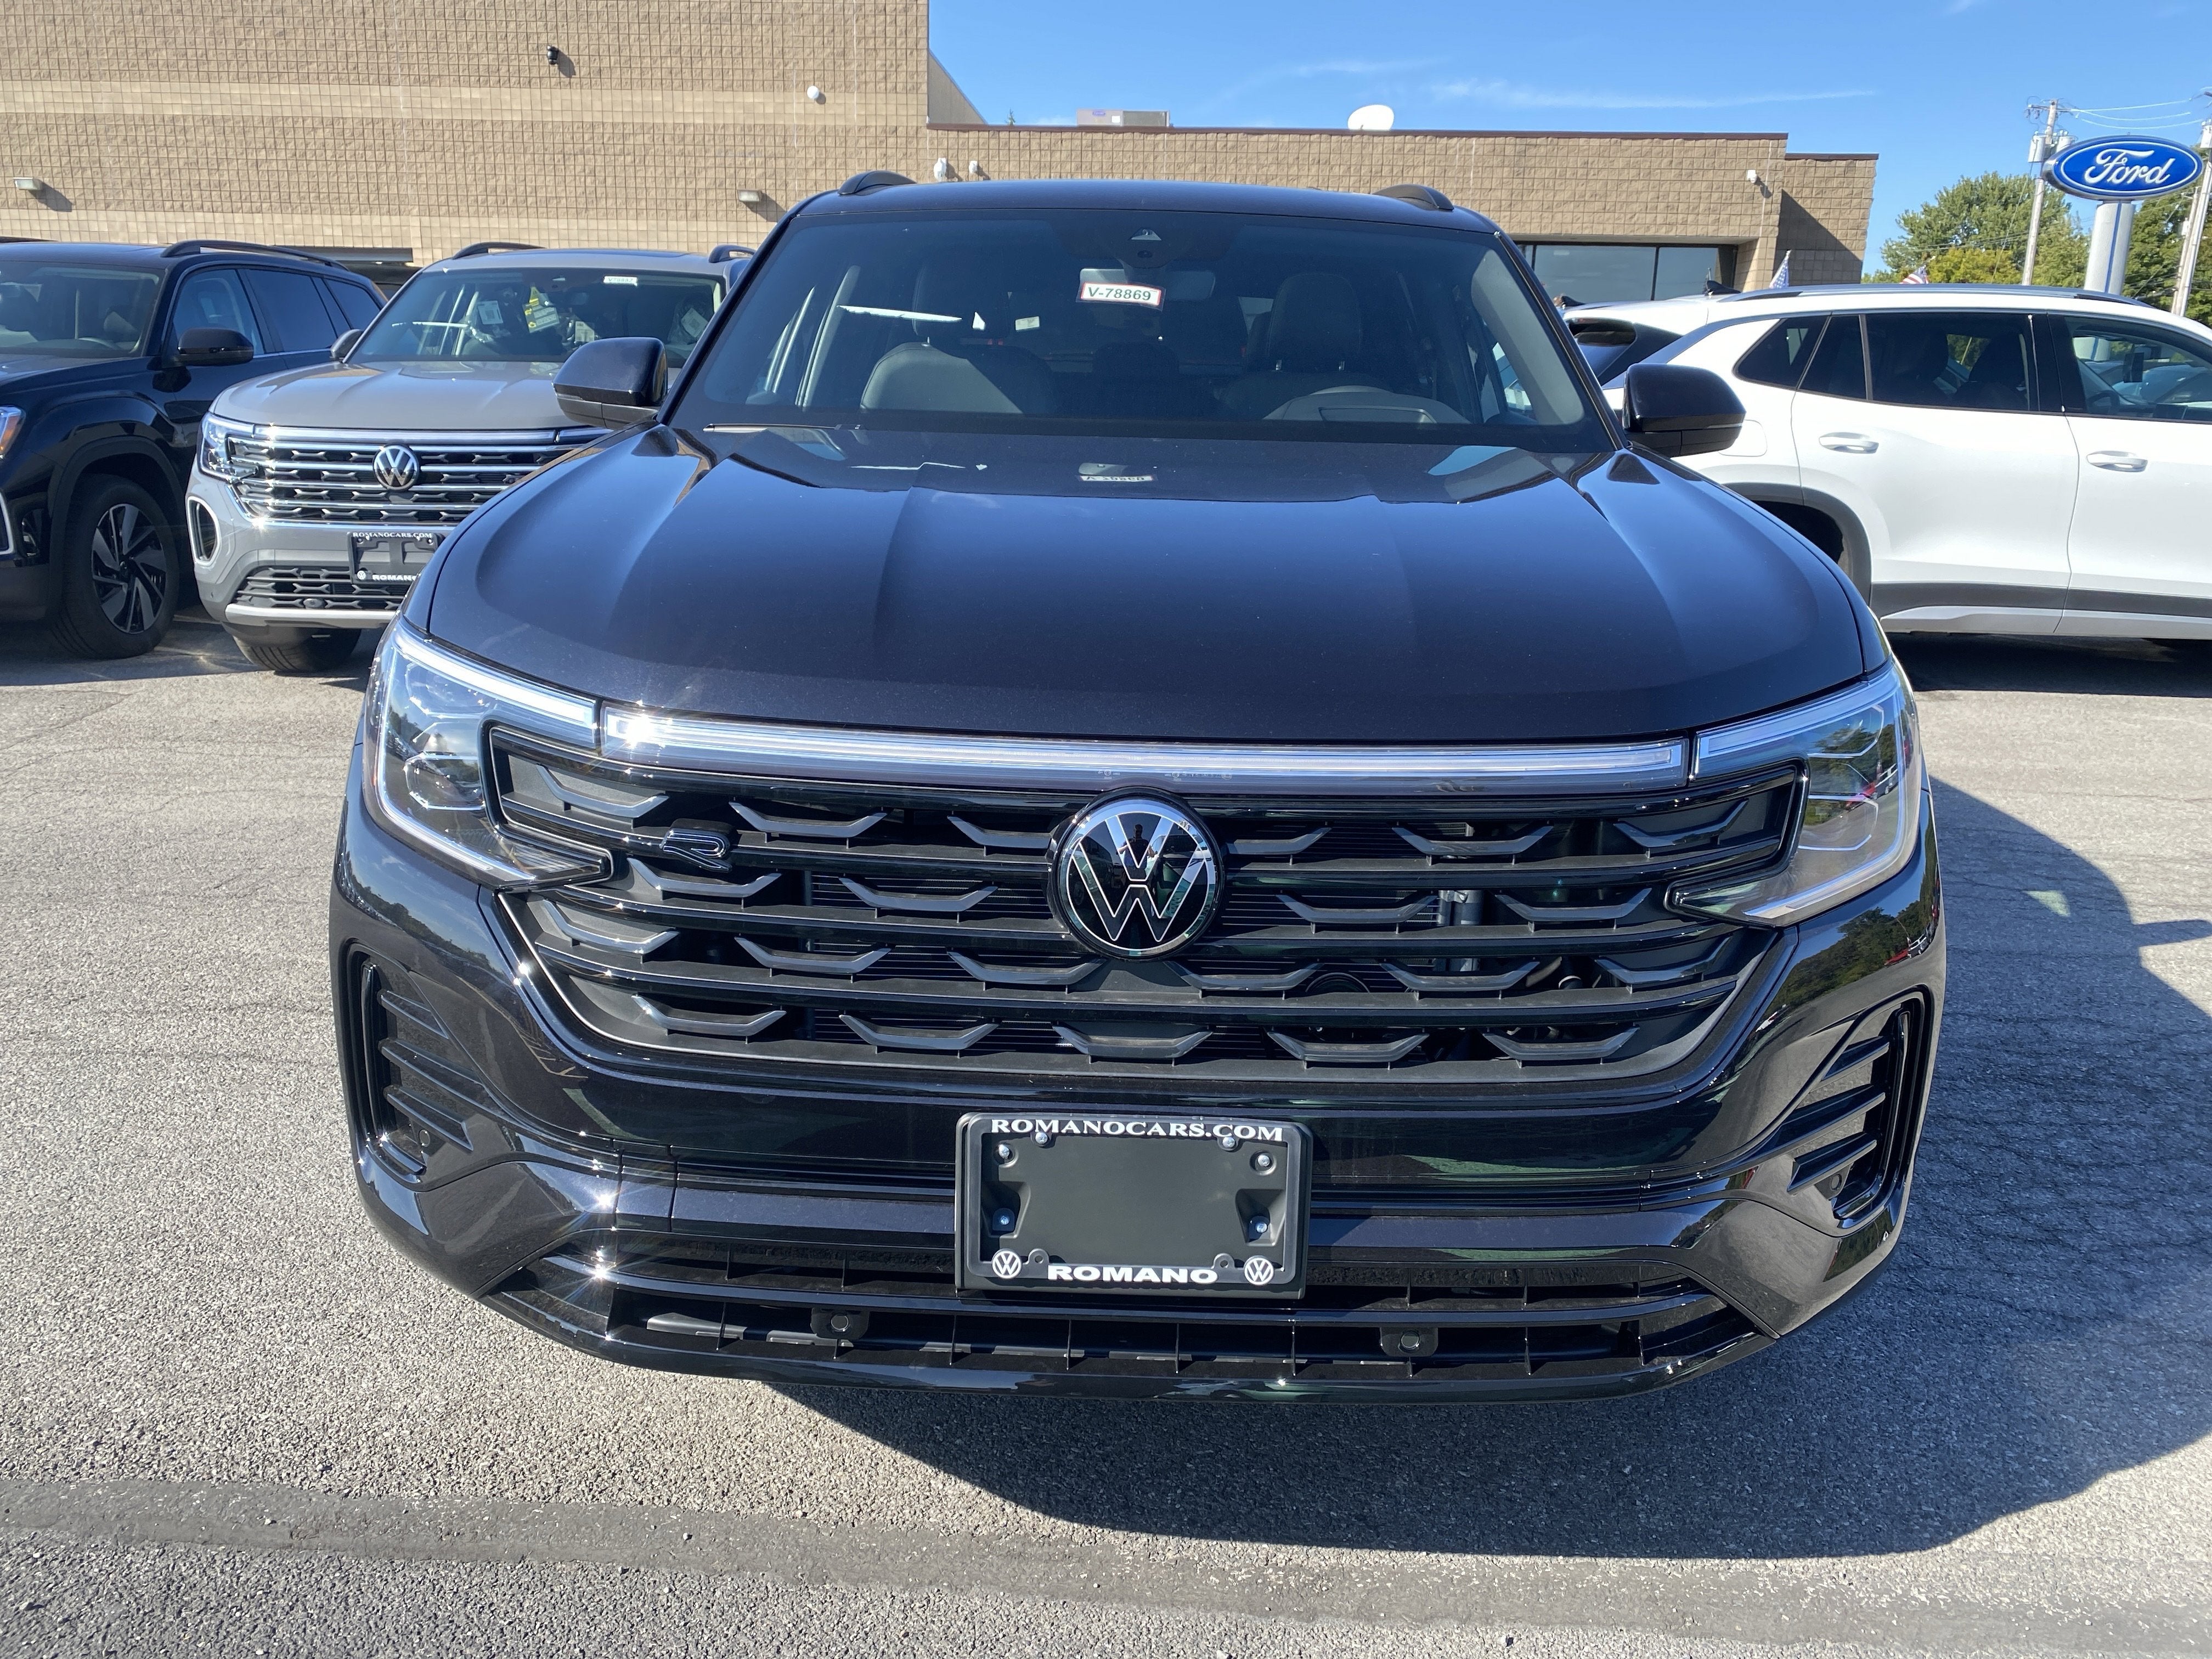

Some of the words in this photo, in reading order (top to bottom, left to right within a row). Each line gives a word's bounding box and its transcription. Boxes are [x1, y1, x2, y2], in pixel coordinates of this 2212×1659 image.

[2085, 148, 2176, 184] Ford
[1088, 286, 1151, 301] V-78869
[375, 447, 417, 487] VW
[1066, 811, 1209, 944] VW
[991, 1119, 1284, 1142] ROMANOCARS.COM
[992, 1250, 1022, 1279] VW
[1047, 1265, 1218, 1284] ROMANO
[1244, 1257, 1274, 1285] VW
